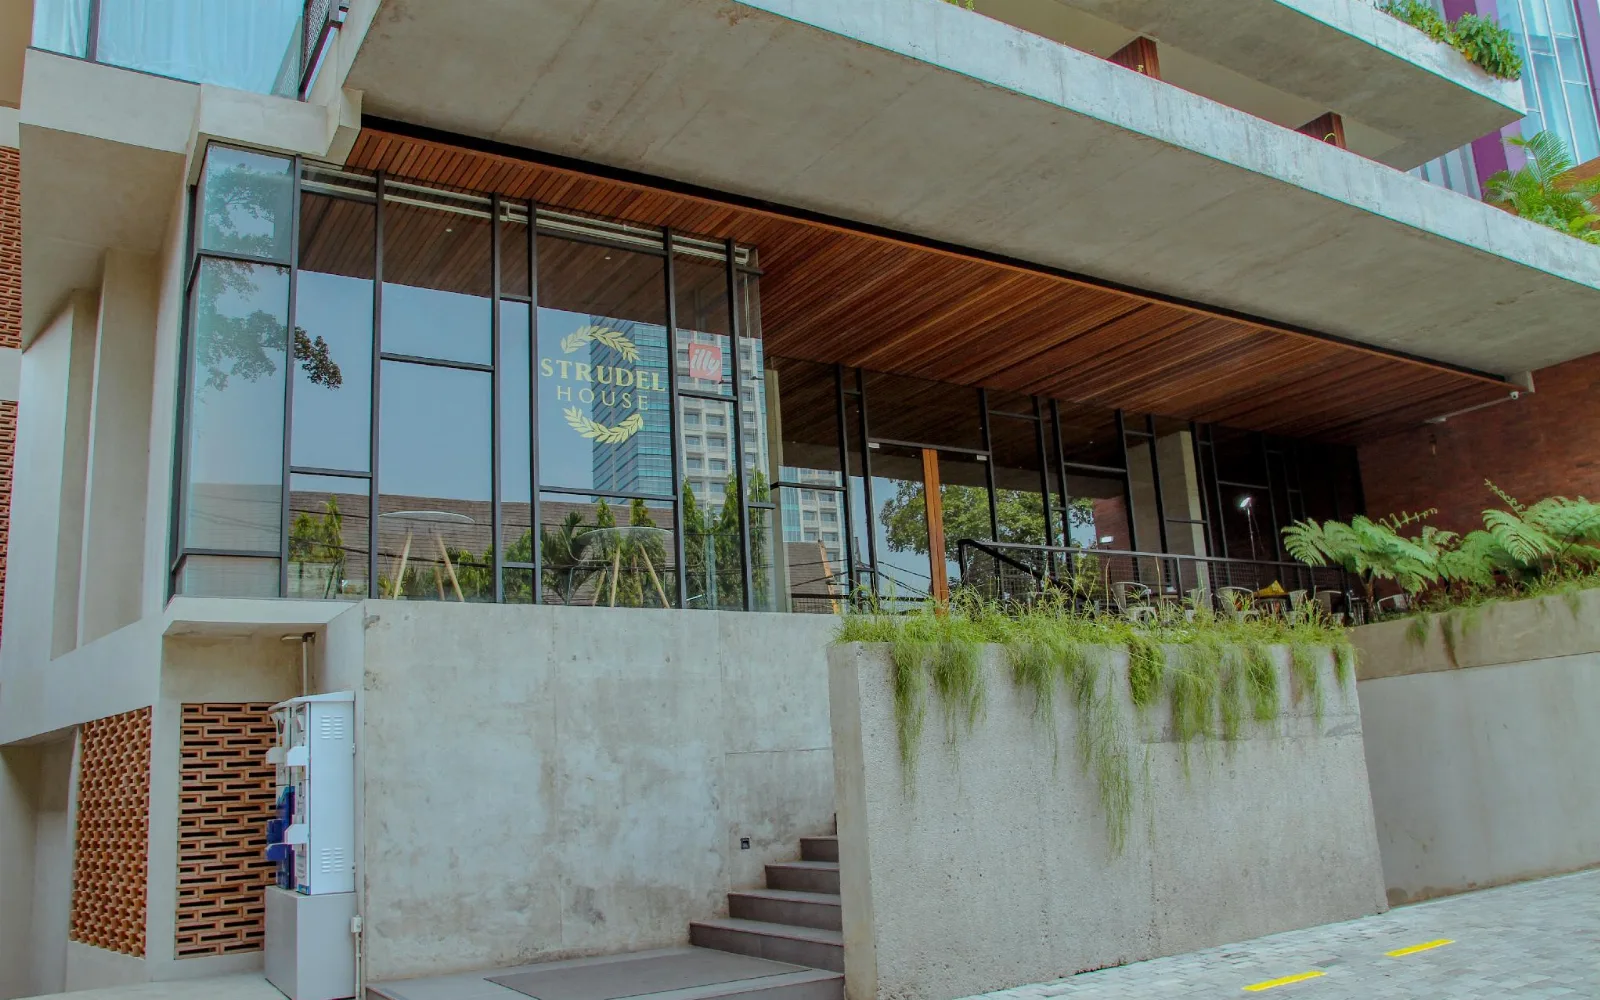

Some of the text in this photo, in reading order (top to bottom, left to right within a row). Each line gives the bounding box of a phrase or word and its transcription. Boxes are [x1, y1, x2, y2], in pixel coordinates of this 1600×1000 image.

[541, 358, 666, 391] STRUDEL
[691, 351, 721, 374] illy
[557, 386, 649, 411] HOUSE
